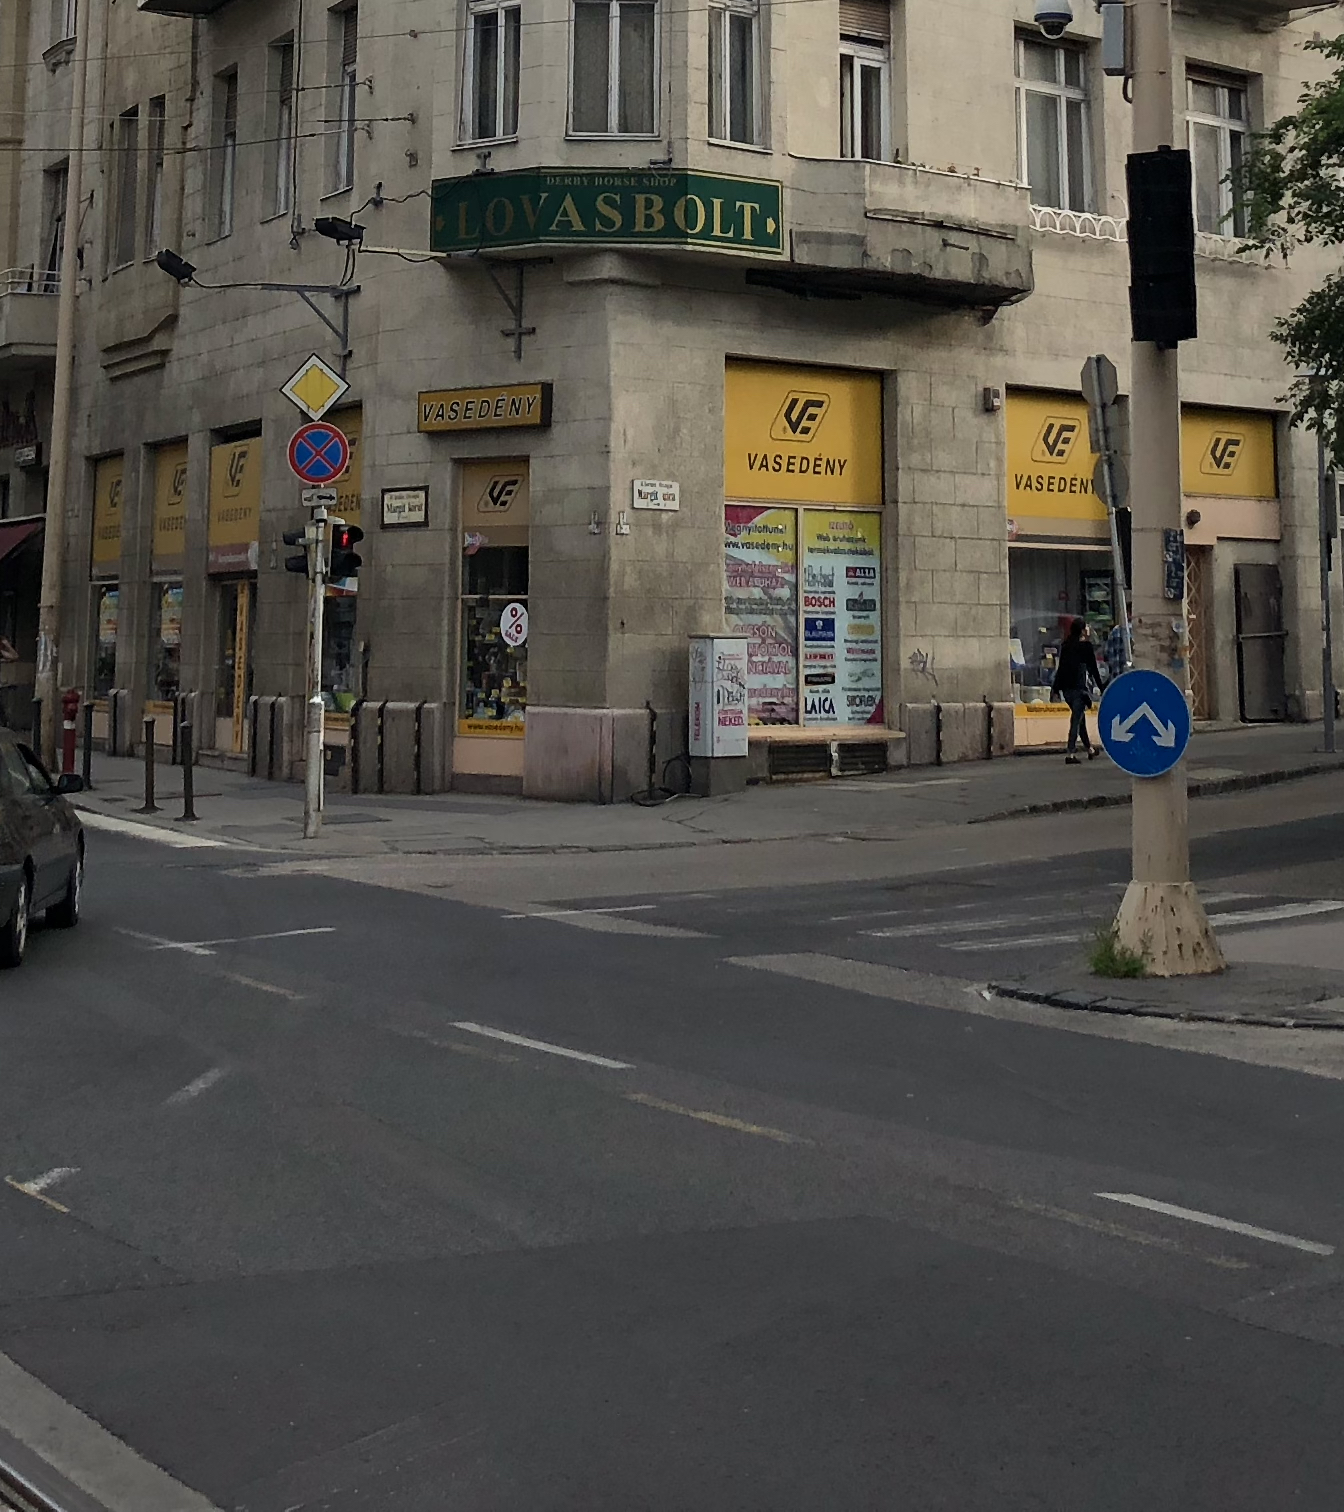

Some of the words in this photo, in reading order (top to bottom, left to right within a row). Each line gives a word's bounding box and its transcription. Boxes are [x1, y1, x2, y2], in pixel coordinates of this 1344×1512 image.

[546, 176, 590, 186] DERBY
[595, 176, 638, 187] HORSE
[643, 176, 677, 187] SHOP
[458, 192, 760, 240] LOVASBOLT
[422, 392, 538, 422] VASEDÉNY
[747, 452, 848, 476] VASEDÉNY
[804, 595, 836, 608] BOSCH
[805, 696, 835, 715] LAICA
